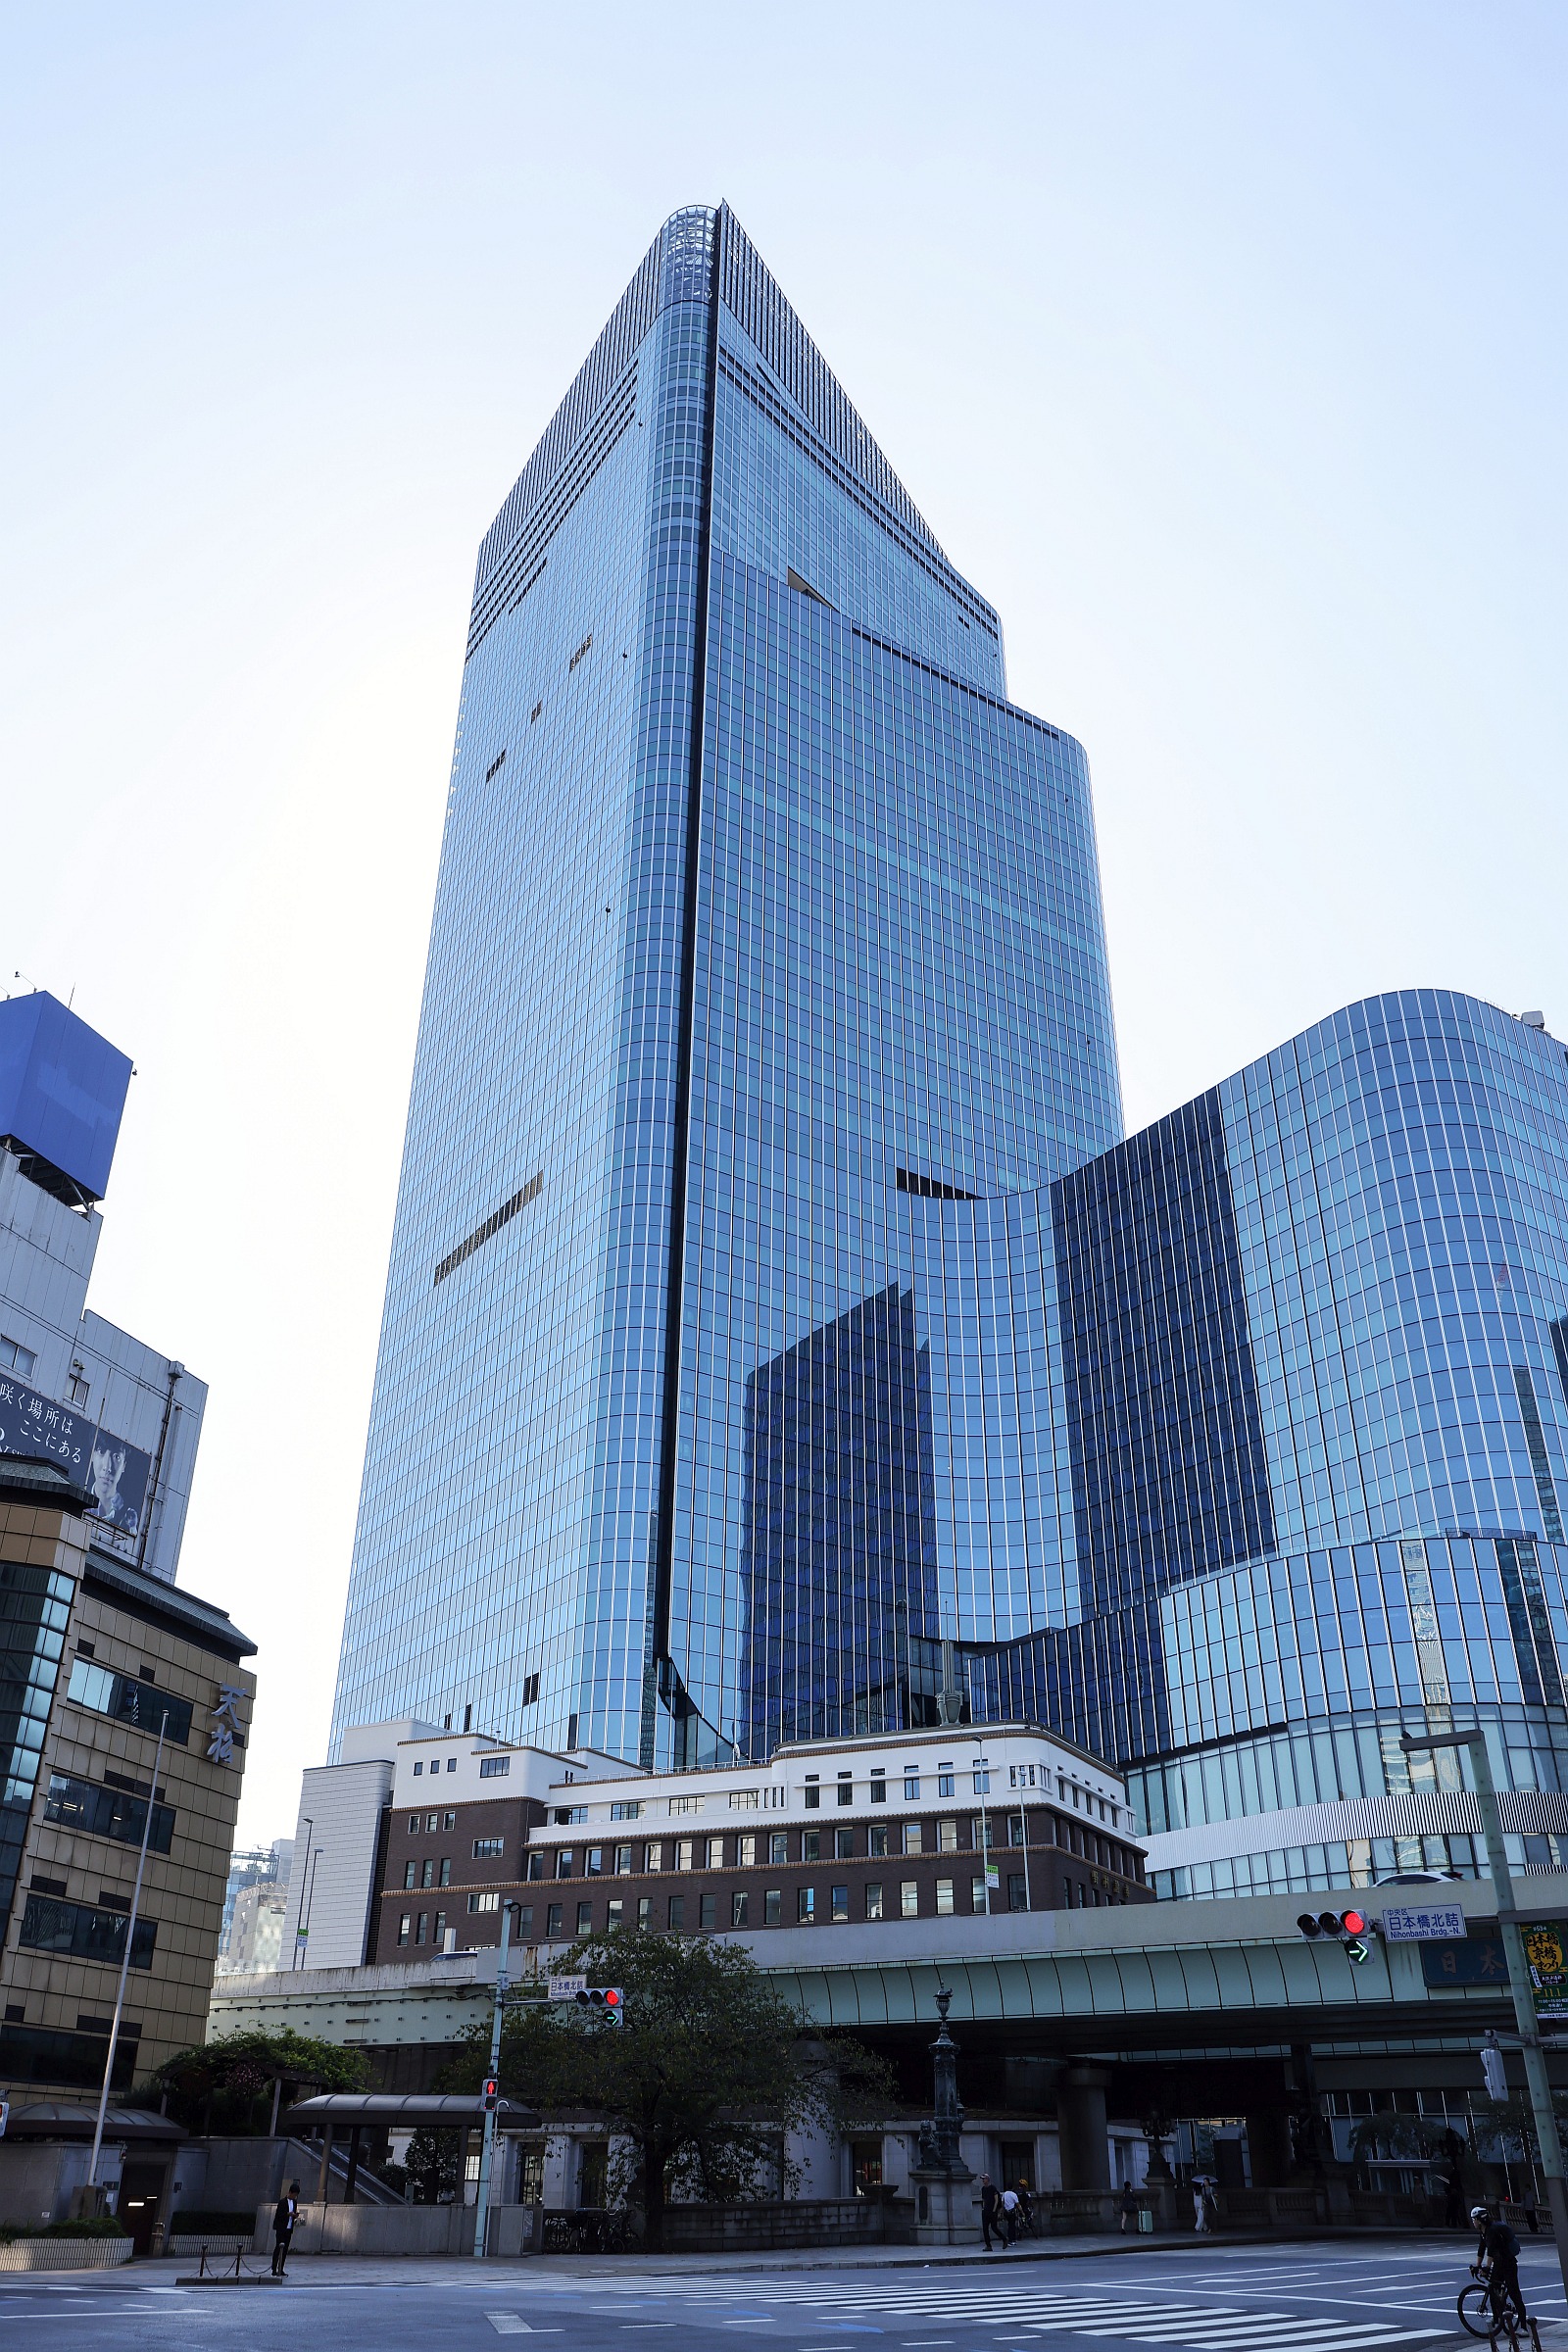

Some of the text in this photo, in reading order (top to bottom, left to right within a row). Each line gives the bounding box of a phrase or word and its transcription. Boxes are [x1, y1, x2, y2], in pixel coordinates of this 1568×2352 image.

[0, 1383, 74, 1435] 咲く場所は
[20, 1419, 81, 1463] ここにある
[1389, 1912, 1459, 1931] 日本橋北詰
[1391, 1929, 1429, 1938] Nihonbashi
[1526, 1932, 1559, 1947] 日本橋
[1533, 1946, 1557, 1960] 京橋
